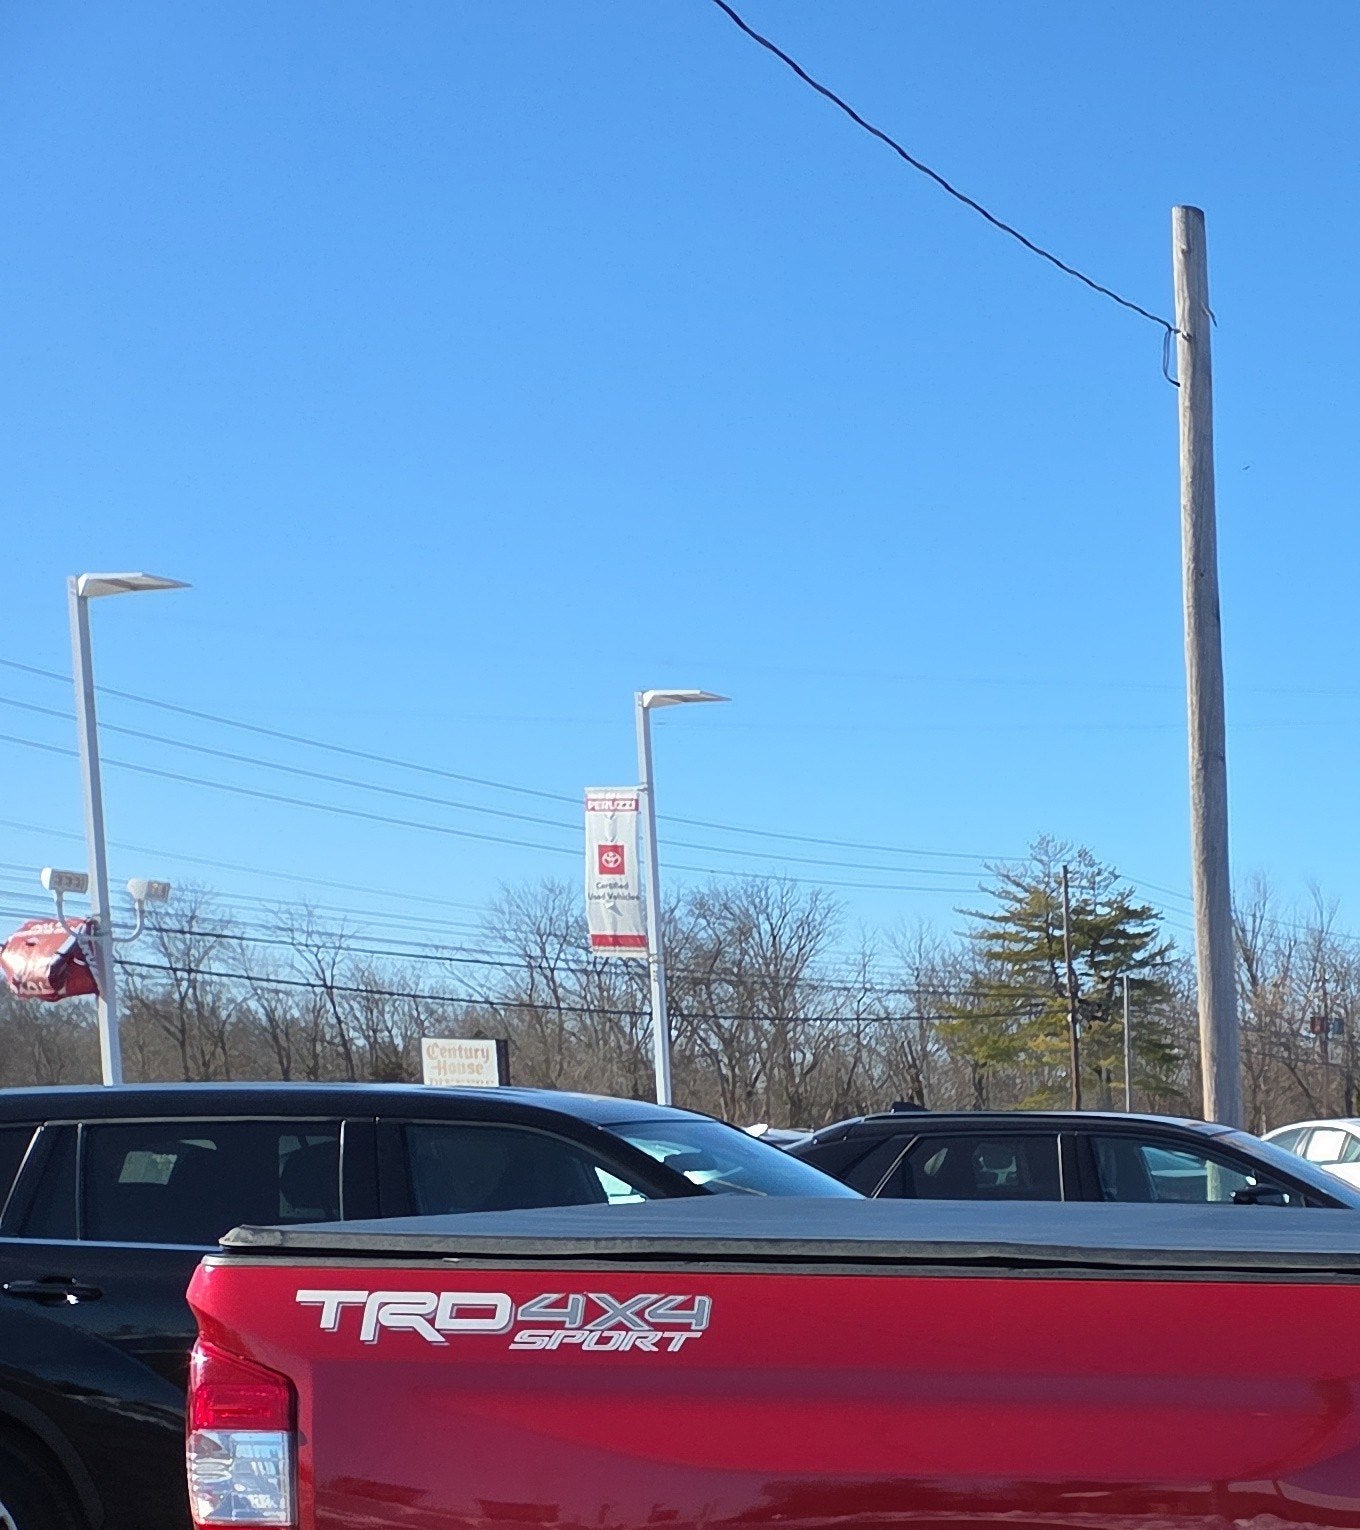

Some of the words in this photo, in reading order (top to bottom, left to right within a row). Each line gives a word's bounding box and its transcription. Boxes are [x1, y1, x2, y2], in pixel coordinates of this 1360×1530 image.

[588, 800, 636, 810] PERUZZI
[426, 1042, 490, 1064] Century
[431, 1060, 484, 1077] House
[296, 1290, 513, 1343] TRD
[509, 1330, 702, 1351] SPORT
